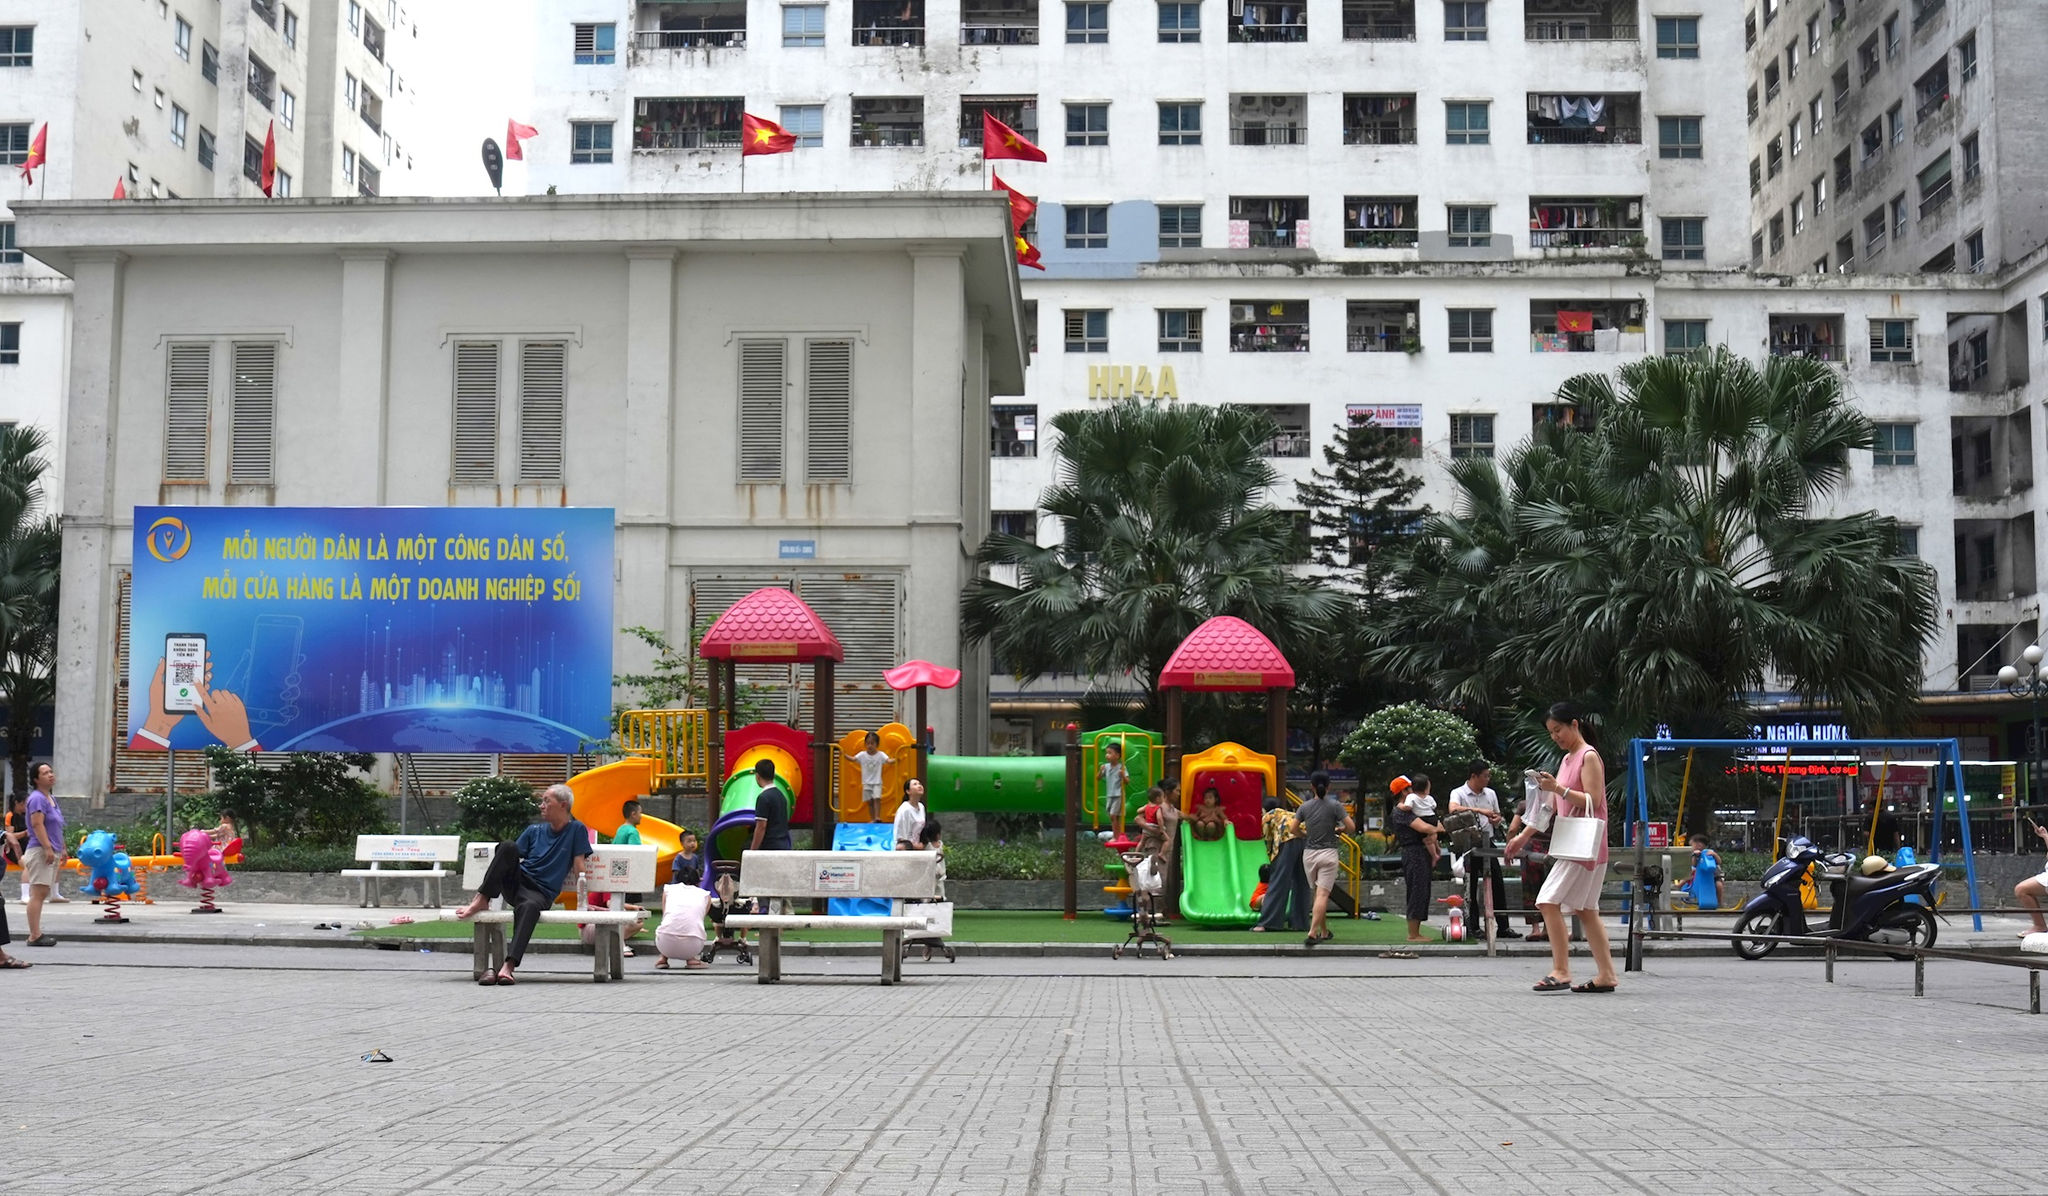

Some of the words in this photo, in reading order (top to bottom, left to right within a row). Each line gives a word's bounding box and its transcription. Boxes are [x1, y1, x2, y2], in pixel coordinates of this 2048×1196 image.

[1089, 365, 1178, 399] HH4A
[222, 529, 258, 560] MỖI
[264, 532, 317, 560] NGƯỜI
[323, 533, 361, 560] DÂN
[367, 533, 389, 560] LÀ
[396, 533, 438, 566] MỘT
[444, 533, 490, 561] CÔNG
[497, 533, 535, 561] DÂN
[541, 530, 570, 563] SỐ,
[202, 568, 238, 599] MỖI
[244, 570, 280, 600] CỬA
[286, 572, 334, 600] HÀNG
[340, 572, 363, 600] LÀ
[370, 573, 412, 606] MỘT
[418, 577, 479, 601] DOANH
[485, 573, 546, 607] NGHIỆP
[552, 570, 582, 601] SỐ!
[1766, 722, 1809, 740] NGHĨA
